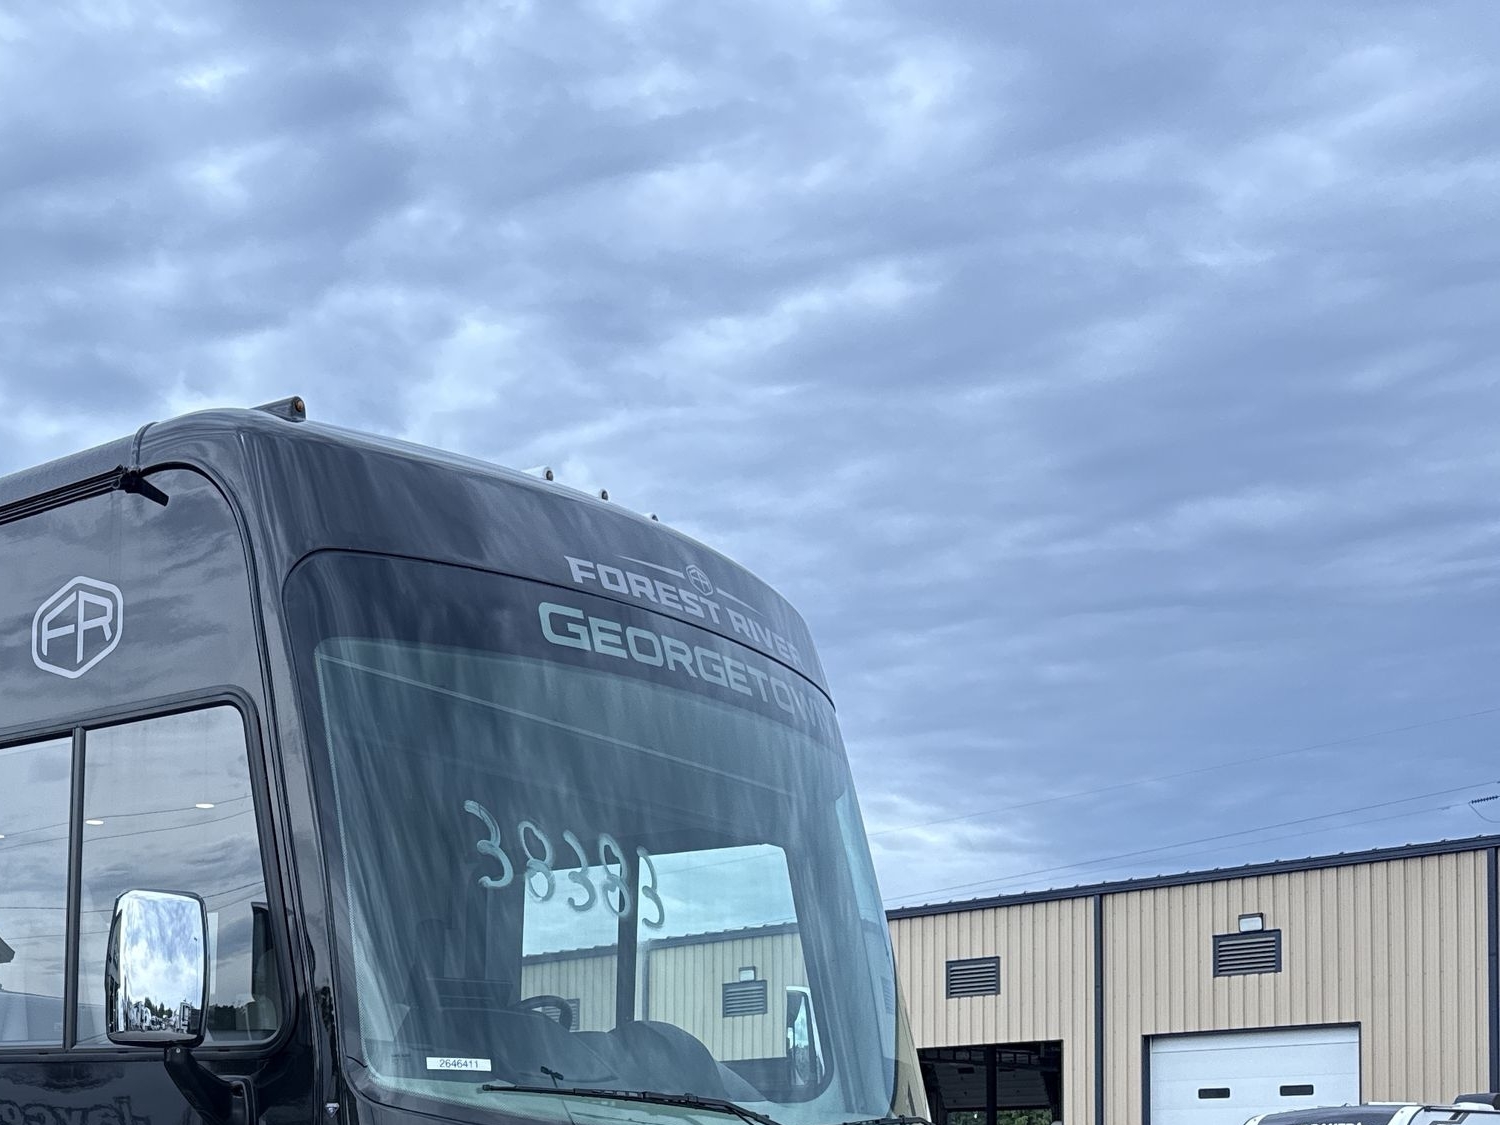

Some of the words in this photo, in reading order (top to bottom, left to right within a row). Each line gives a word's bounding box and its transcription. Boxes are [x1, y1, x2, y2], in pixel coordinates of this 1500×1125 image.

[538, 601, 834, 738] GEORGETOWN
[563, 555, 721, 625] FOREST
[731, 607, 805, 673] RIVER
[464, 799, 665, 930] 38383
[439, 1059, 478, 1068] 2646411
